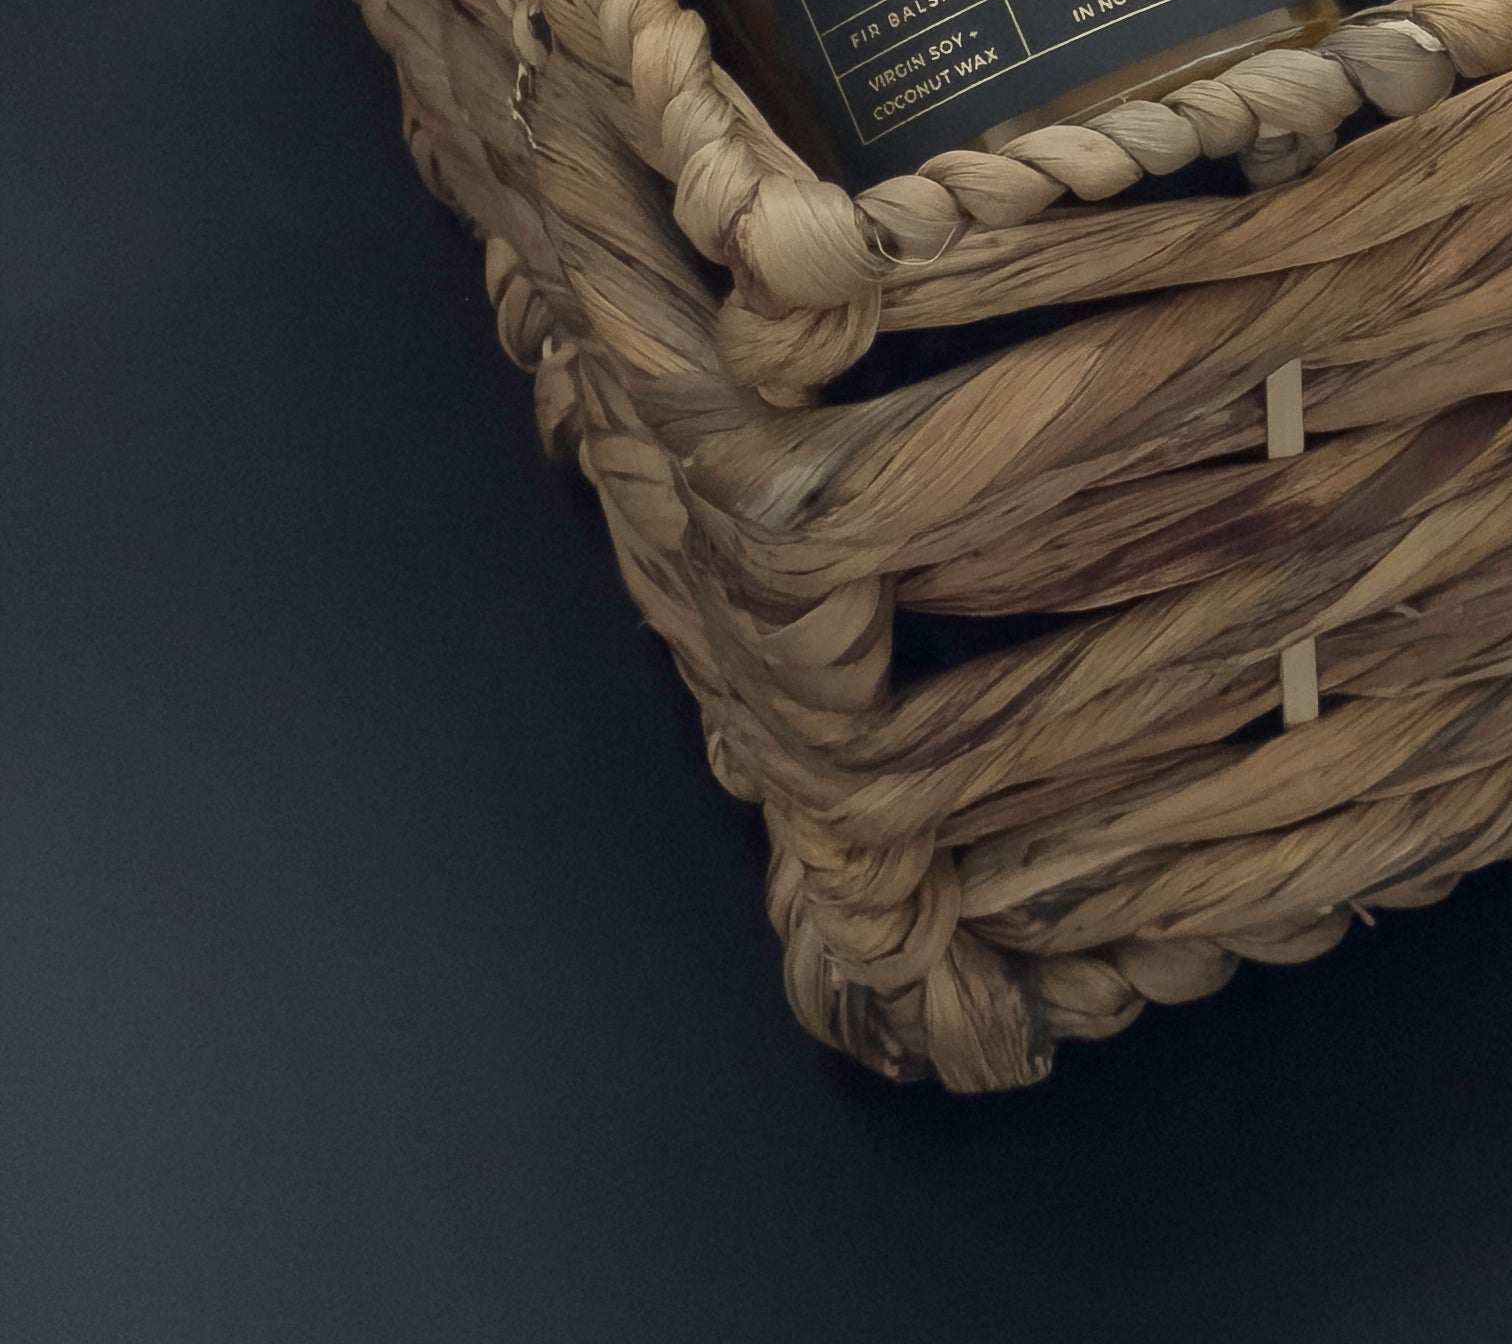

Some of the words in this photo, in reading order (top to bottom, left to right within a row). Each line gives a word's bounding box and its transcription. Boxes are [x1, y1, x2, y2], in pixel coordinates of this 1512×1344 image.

[1072, 3, 1095, 23] IN
[850, 24, 882, 49] FIR
[868, 54, 925, 93] VIRGIN
[929, 32, 964, 60] SOY
[872, 72, 952, 121] COCONUT
[954, 46, 999, 77] WAX
